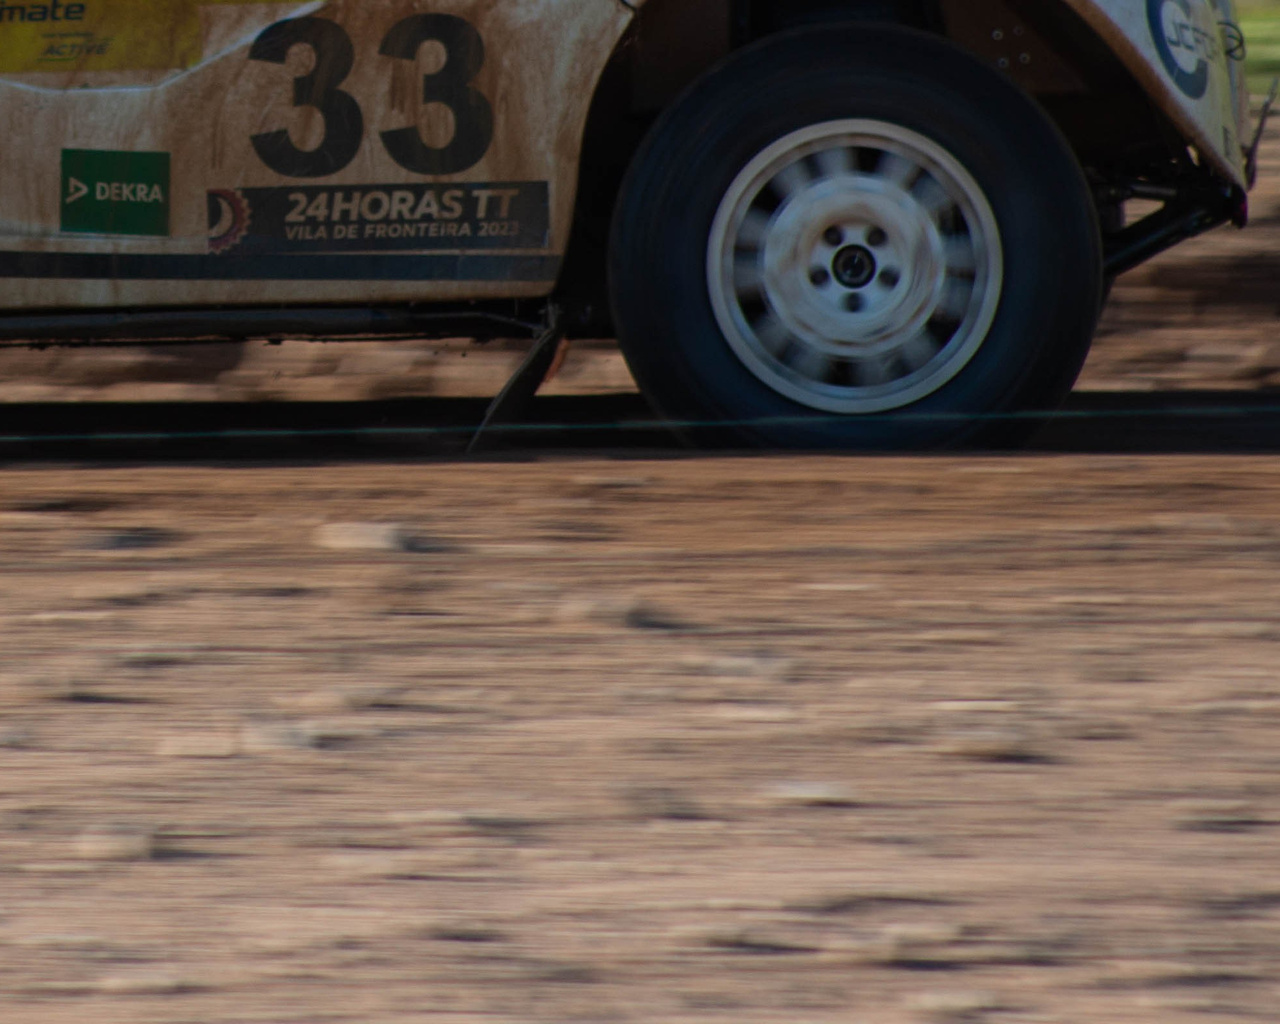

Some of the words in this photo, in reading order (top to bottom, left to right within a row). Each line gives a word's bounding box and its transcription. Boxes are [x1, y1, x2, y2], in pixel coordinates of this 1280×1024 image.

[247, 12, 495, 179] 33
[94, 181, 164, 203] DEKRA
[284, 189, 464, 223] 24HORAS
[470, 188, 519, 220] TT
[285, 223, 328, 240] VILA
[332, 223, 360, 238] DE
[362, 221, 471, 238] FRONTEIRA
